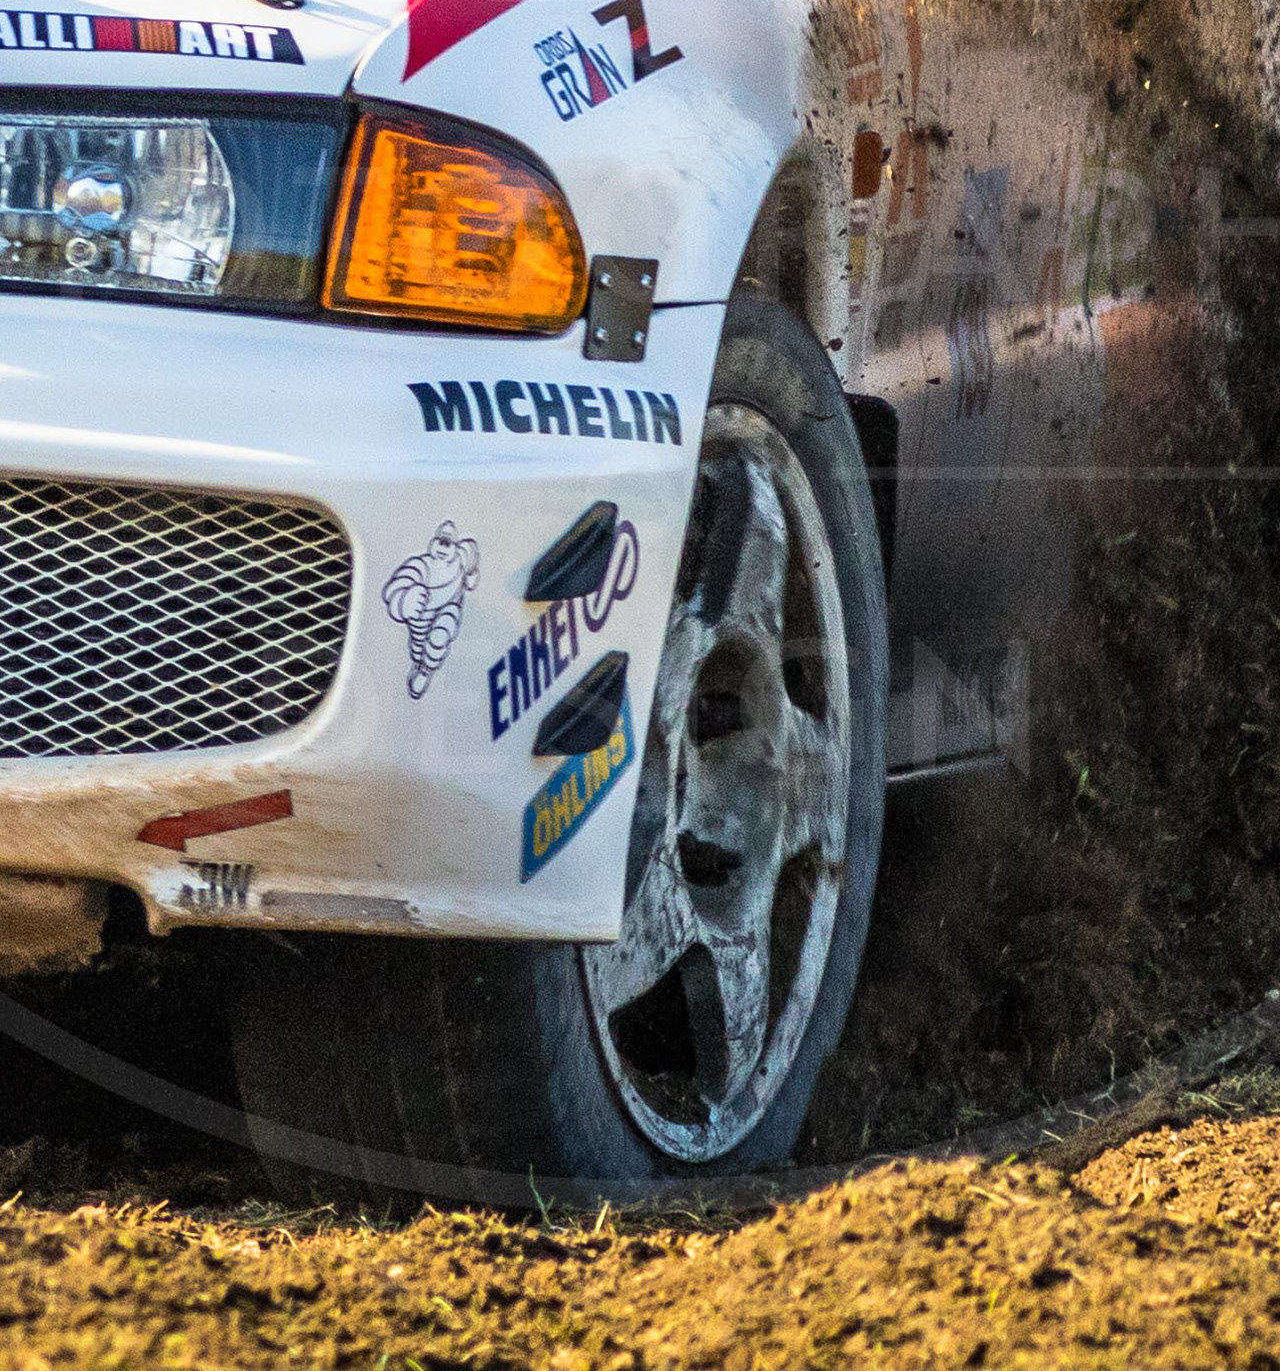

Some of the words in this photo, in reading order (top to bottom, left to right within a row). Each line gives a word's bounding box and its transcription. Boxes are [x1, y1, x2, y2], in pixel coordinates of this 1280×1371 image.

[177, 20, 280, 63] ART
[539, 25, 629, 122] GRAN
[407, 380, 683, 446] MICHELIN
[487, 597, 581, 743] ENKEI
